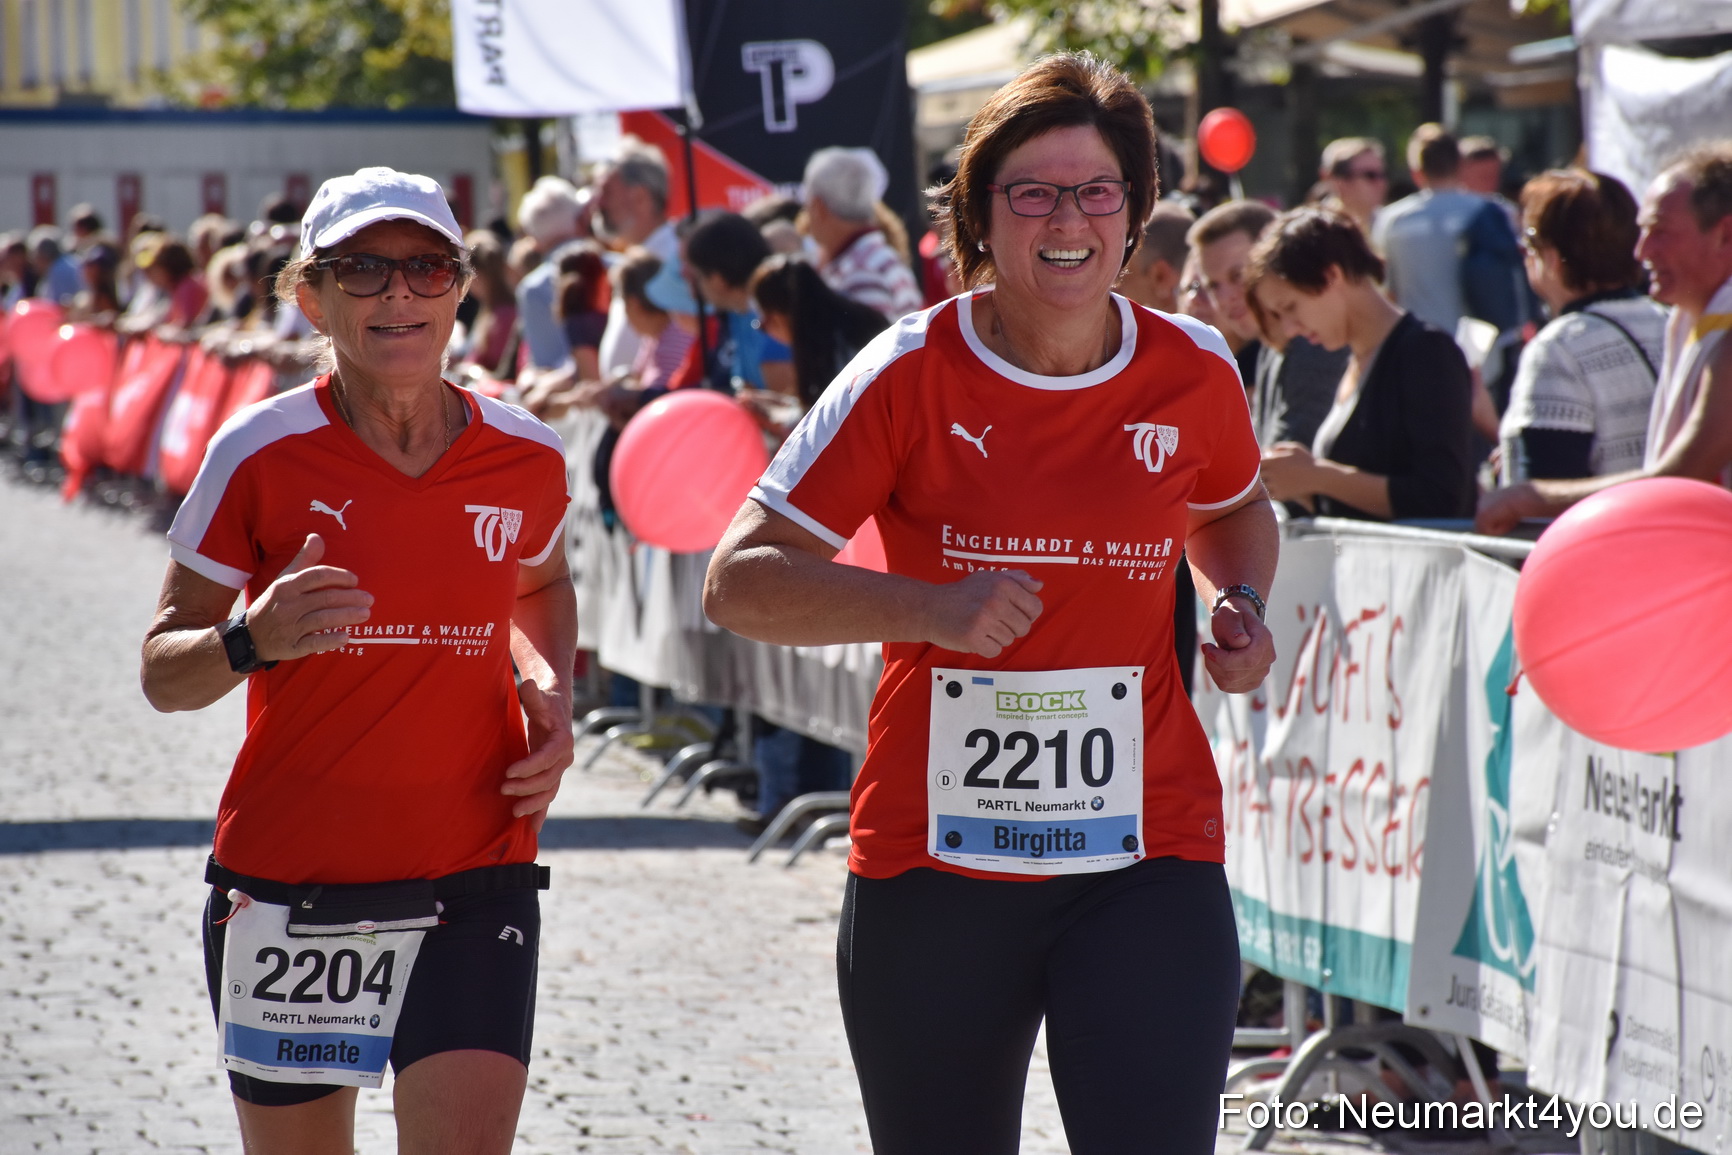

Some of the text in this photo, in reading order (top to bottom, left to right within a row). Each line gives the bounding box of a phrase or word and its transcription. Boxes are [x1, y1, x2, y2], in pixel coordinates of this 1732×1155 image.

[942, 524, 1174, 557] ENGELHARDT & WALTER
[1082, 557, 1168, 569] DAS HERRENHAUS
[1127, 568, 1164, 581] Lauf
[422, 625, 431, 636] &
[439, 622, 495, 637] WALTER
[442, 638, 489, 646] HERRENHAUS
[456, 646, 486, 656] Lauf
[996, 690, 1088, 713] BOCK
[996, 712, 1024, 721] inspired
[1025, 712, 1034, 721] by
[1058, 712, 1088, 720] concepts
[963, 727, 1114, 790] 2210
[977, 798, 1086, 812] PARTL Neumarkt
[993, 825, 1086, 857] Birgitta
[252, 946, 396, 1005] 2204
[262, 1011, 366, 1026] PARTL Neumarkt
[276, 1038, 360, 1064] Renate
